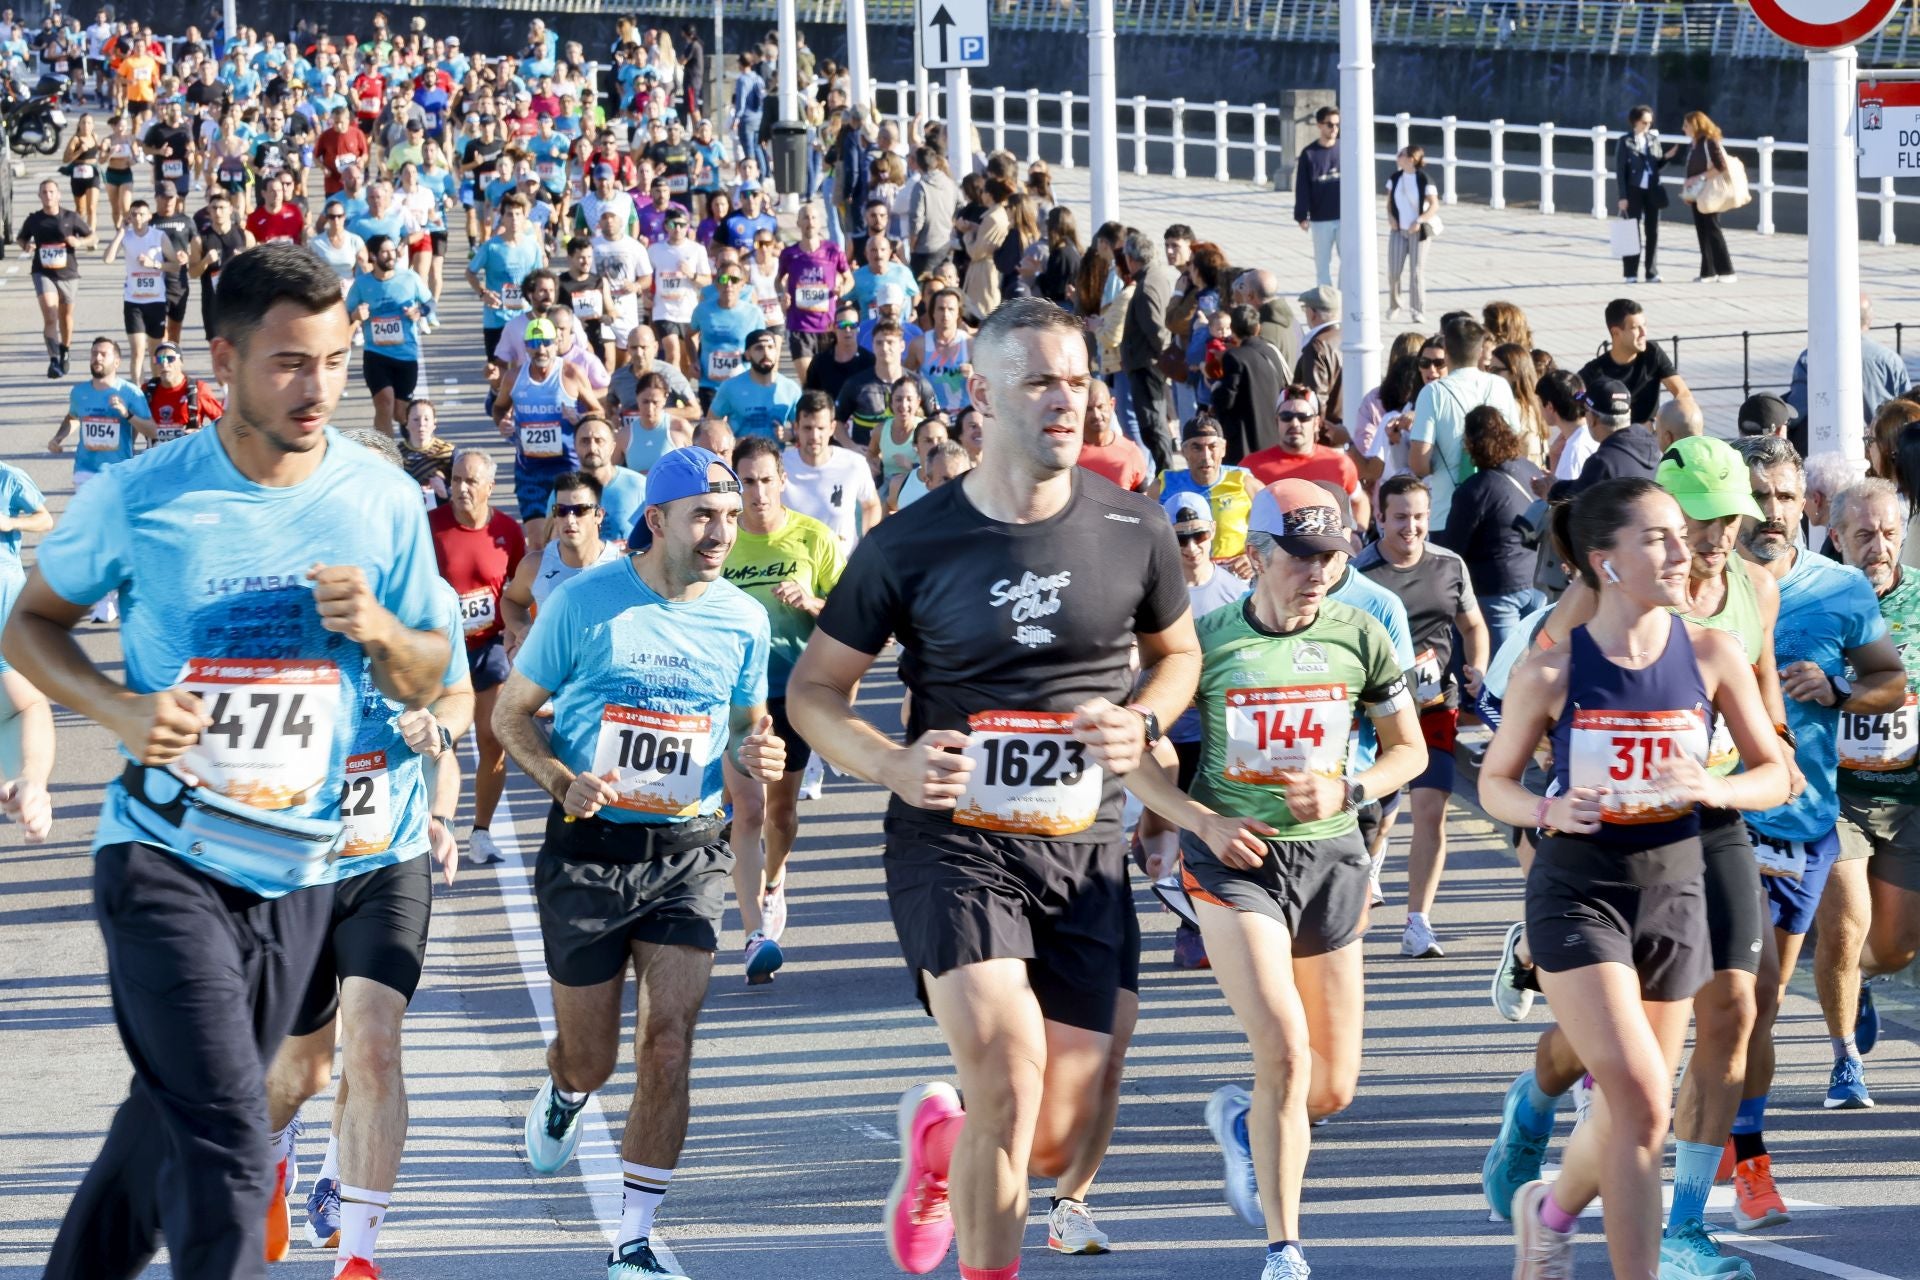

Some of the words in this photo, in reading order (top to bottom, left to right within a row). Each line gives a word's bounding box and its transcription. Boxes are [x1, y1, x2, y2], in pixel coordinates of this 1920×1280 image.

[963, 38, 981, 60] P
[136, 278, 155, 288] 859
[374, 323, 400, 334] 2400
[85, 424, 115, 438] 1054
[526, 429, 557, 443] 2291
[244, 575, 298, 592] MBA
[630, 653, 652, 664] 14ª
[654, 655, 689, 669] MBA
[644, 673, 689, 687] media
[188, 691, 312, 749] 474
[1841, 711, 1907, 741] 1645
[1253, 708, 1324, 750] 144
[618, 729, 693, 776] 1061
[349, 759, 372, 769] GIJÓN
[982, 738, 1087, 786] 1623
